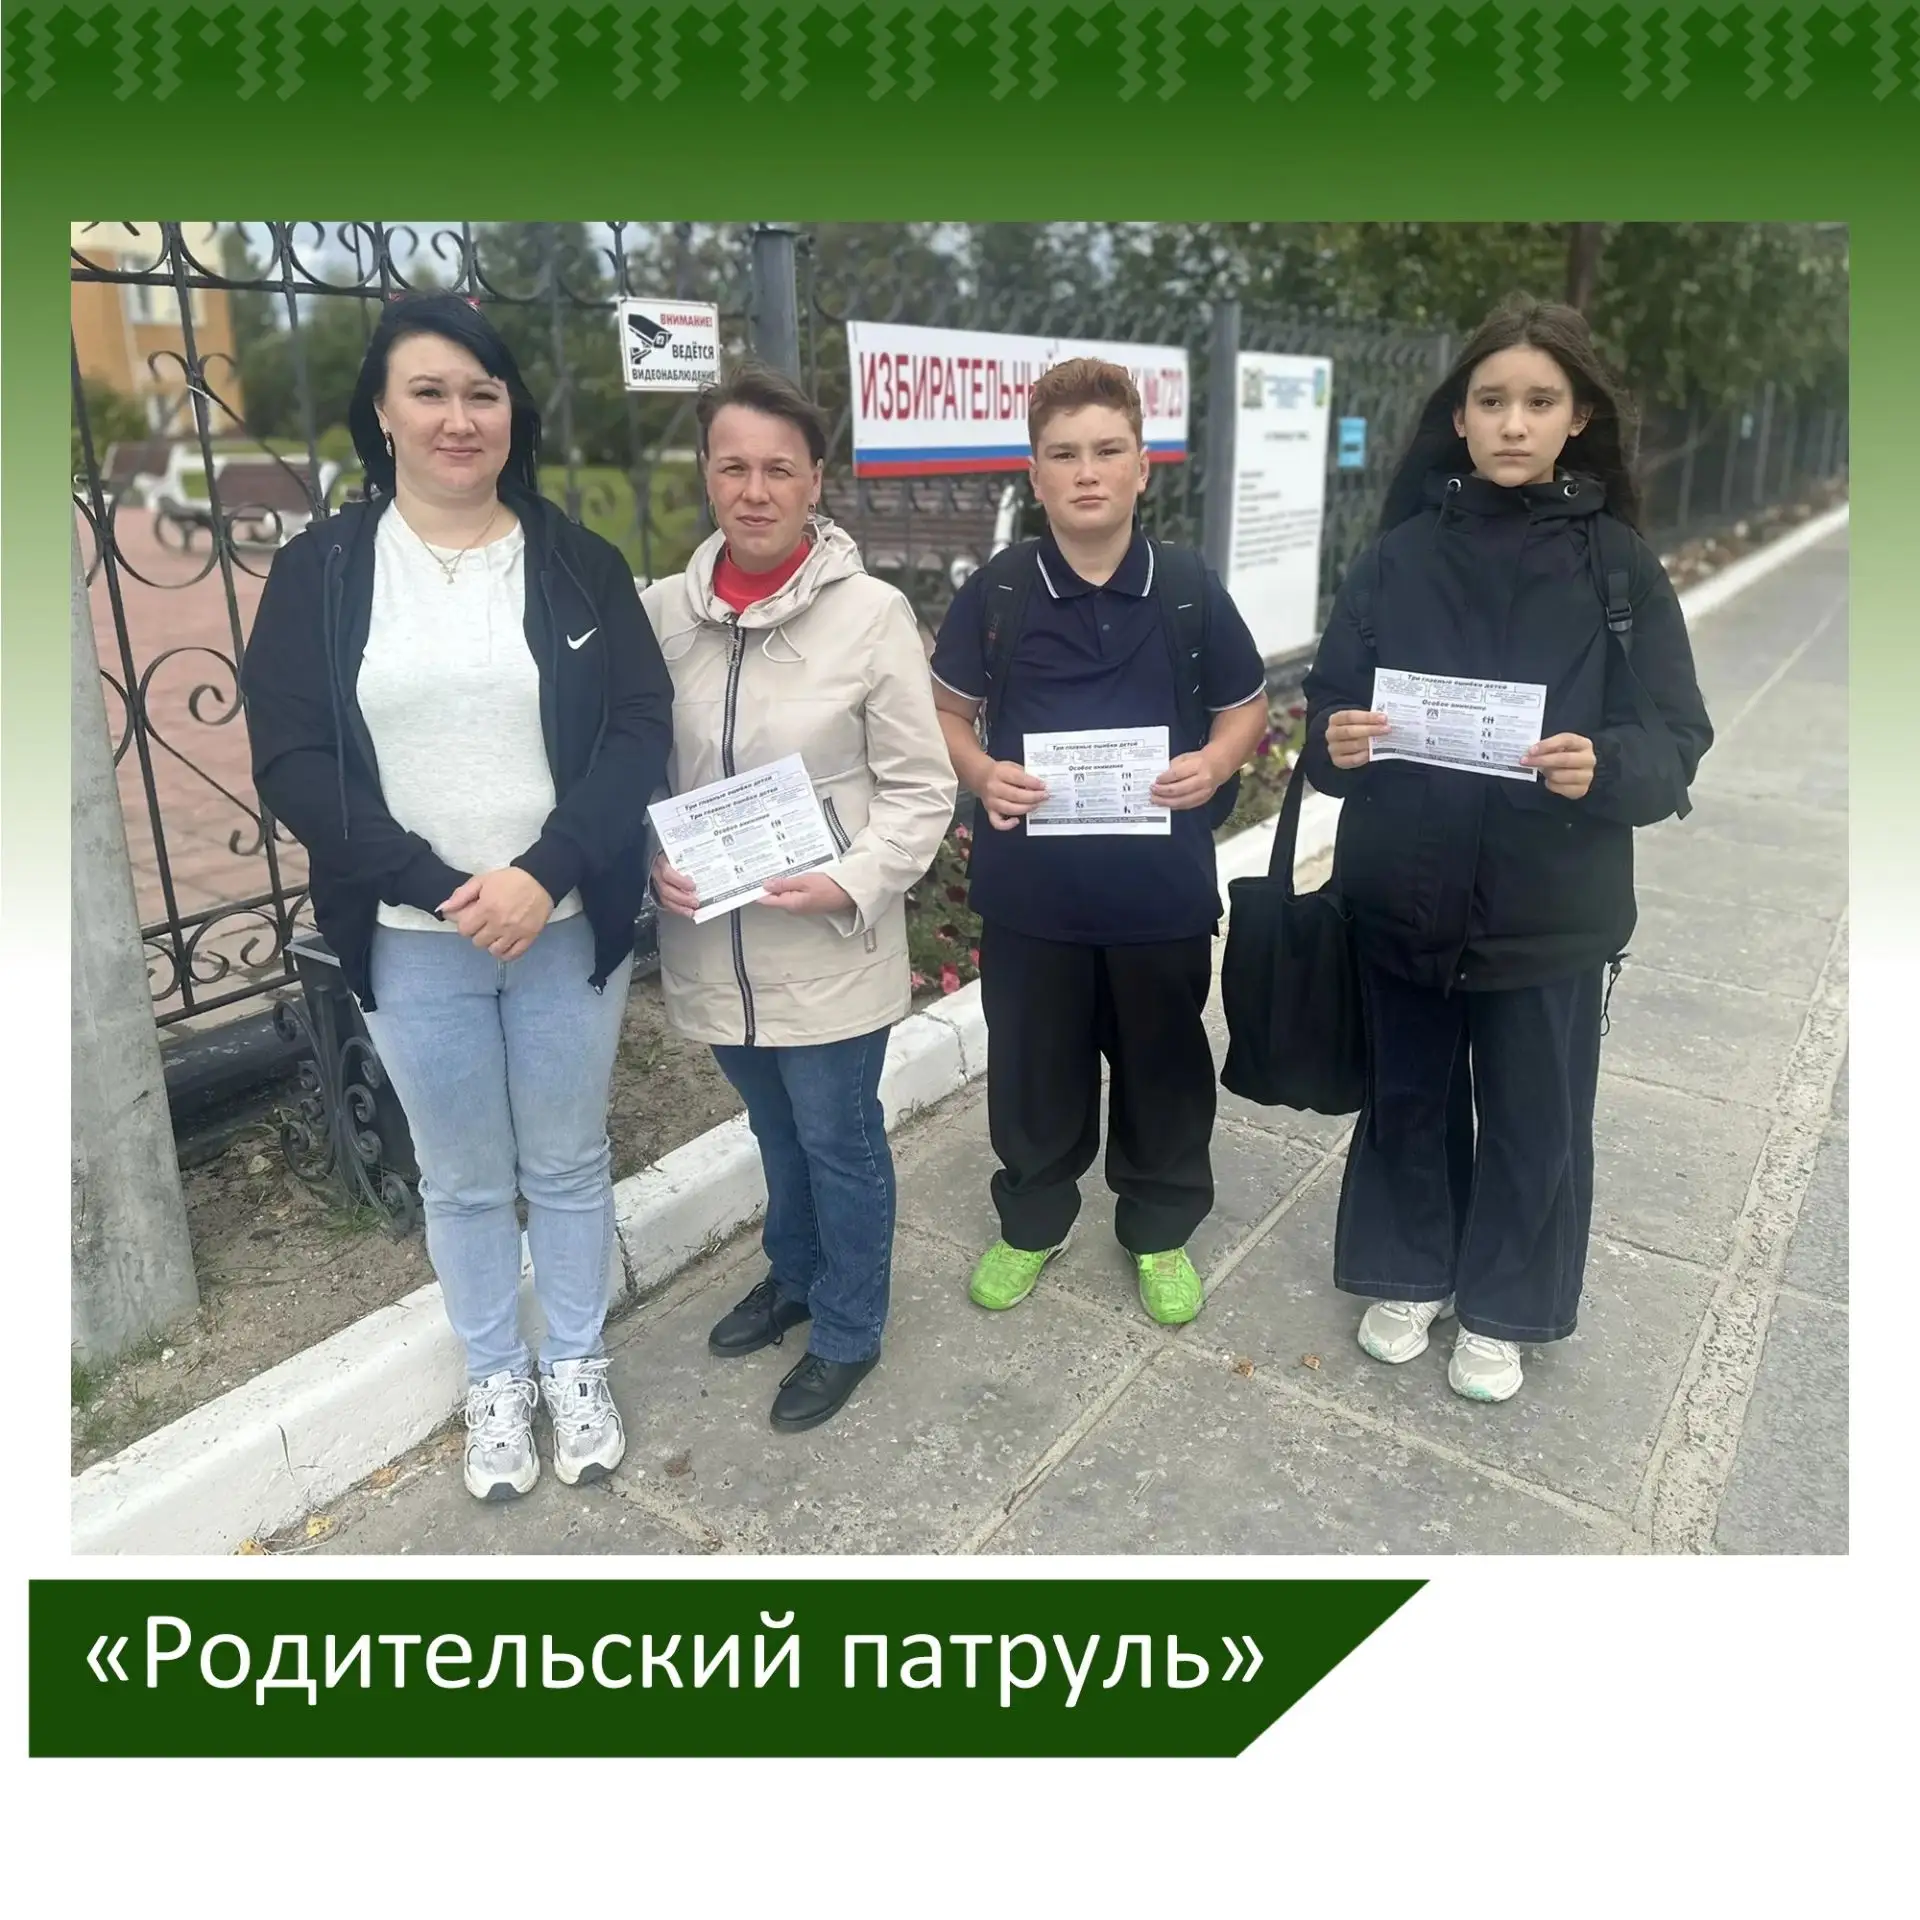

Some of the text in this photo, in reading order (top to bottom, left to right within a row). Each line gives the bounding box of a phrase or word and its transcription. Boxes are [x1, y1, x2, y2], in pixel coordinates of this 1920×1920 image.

[660, 314, 712, 327] ВНИМАНИЕ!
[672, 342, 715, 361] ВЕДЁТСЯ
[632, 367, 716, 383] ВИДЕОНАБЛЮДЕНИЕ
[860, 351, 1052, 422] ИЗБИРАТЕЛЬН
